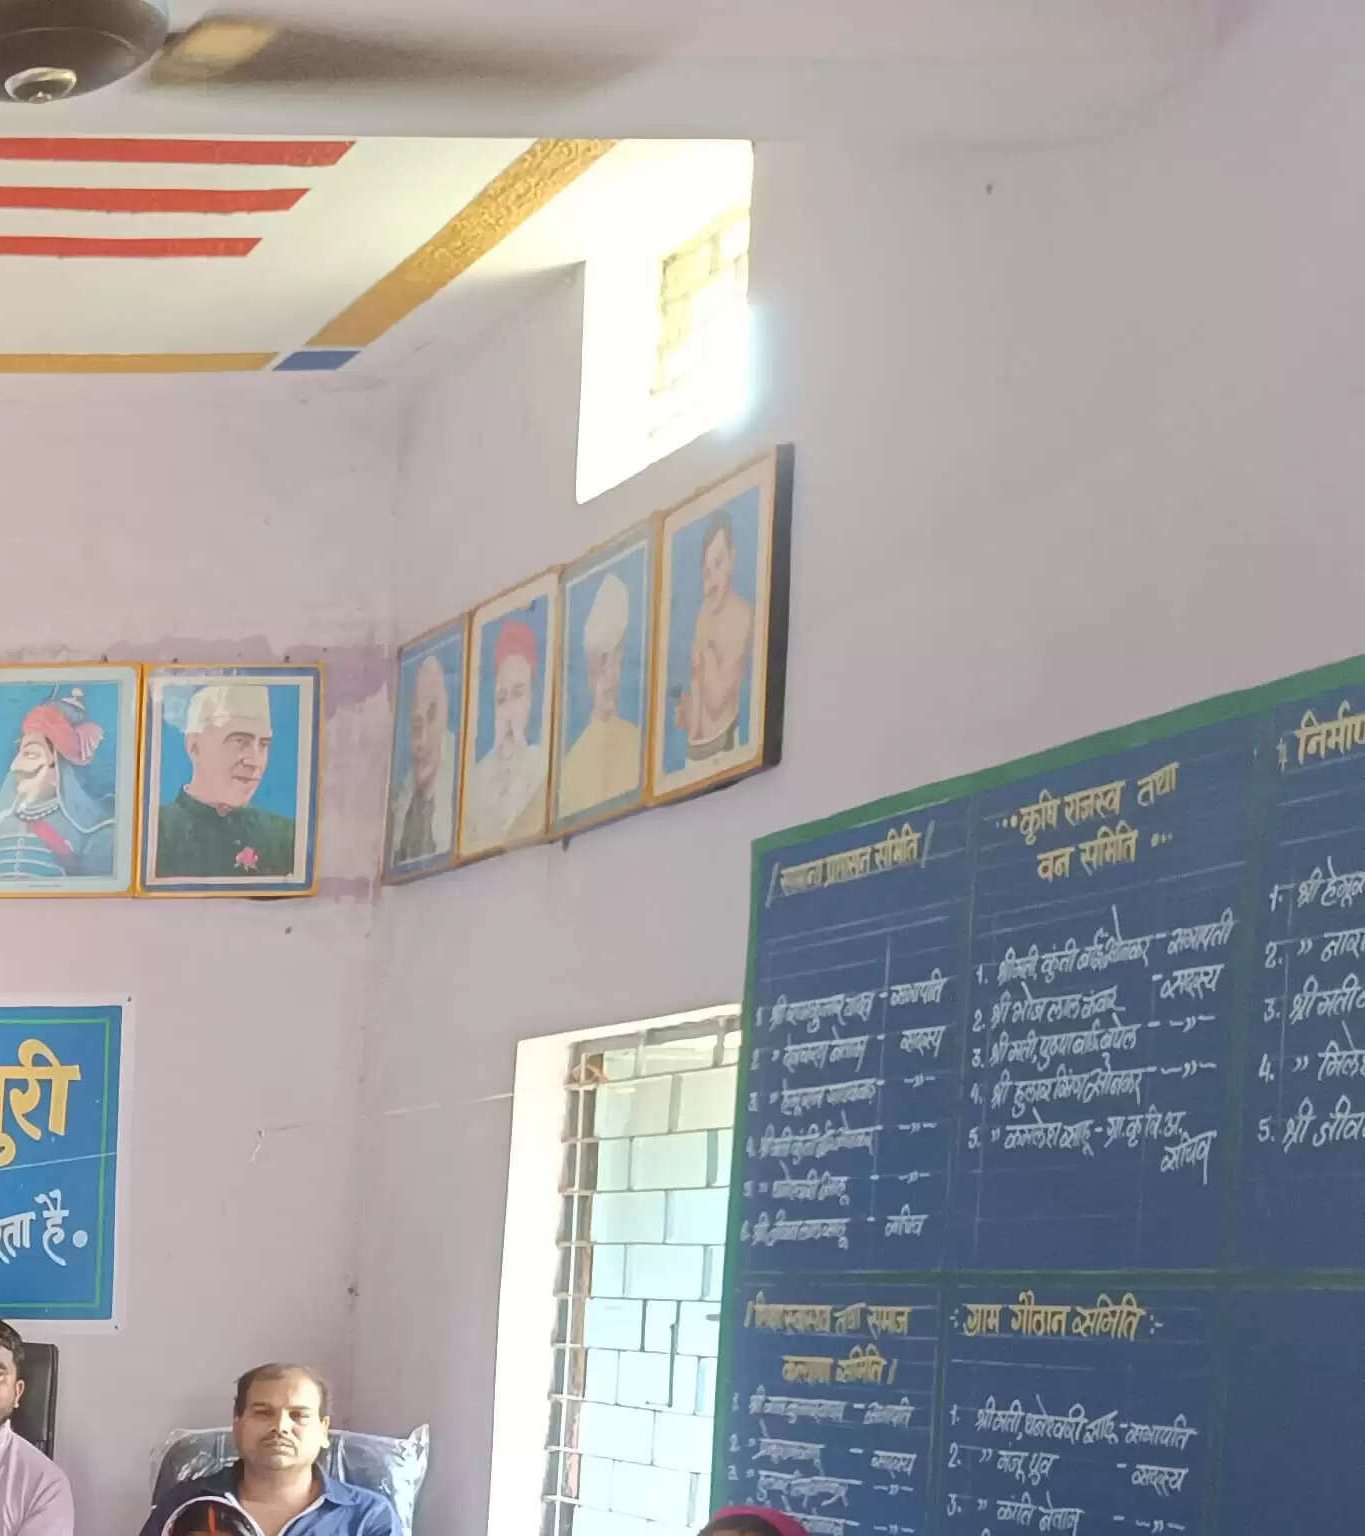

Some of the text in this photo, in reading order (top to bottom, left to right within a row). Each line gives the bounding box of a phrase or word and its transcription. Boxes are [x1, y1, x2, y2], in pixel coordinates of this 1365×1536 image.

[1064, 780, 1126, 826] राजस्व
[1137, 761, 1180, 807] तथा
[1037, 819, 1139, 882] वन समिति
[990, 990, 1012, 1030] श्री
[1159, 962, 1226, 999] सदस्य
[1264, 998, 1281, 1022] 3.
[991, 1069, 1015, 1110] श्री
[1258, 1053, 1275, 1083] 4.
[1257, 1096, 1315, 1153] 5. श्री
[962, 1303, 1003, 1337] ग्राम
[1072, 1292, 1147, 1342] समिति
[1124, 1413, 1198, 1450] सभापति
